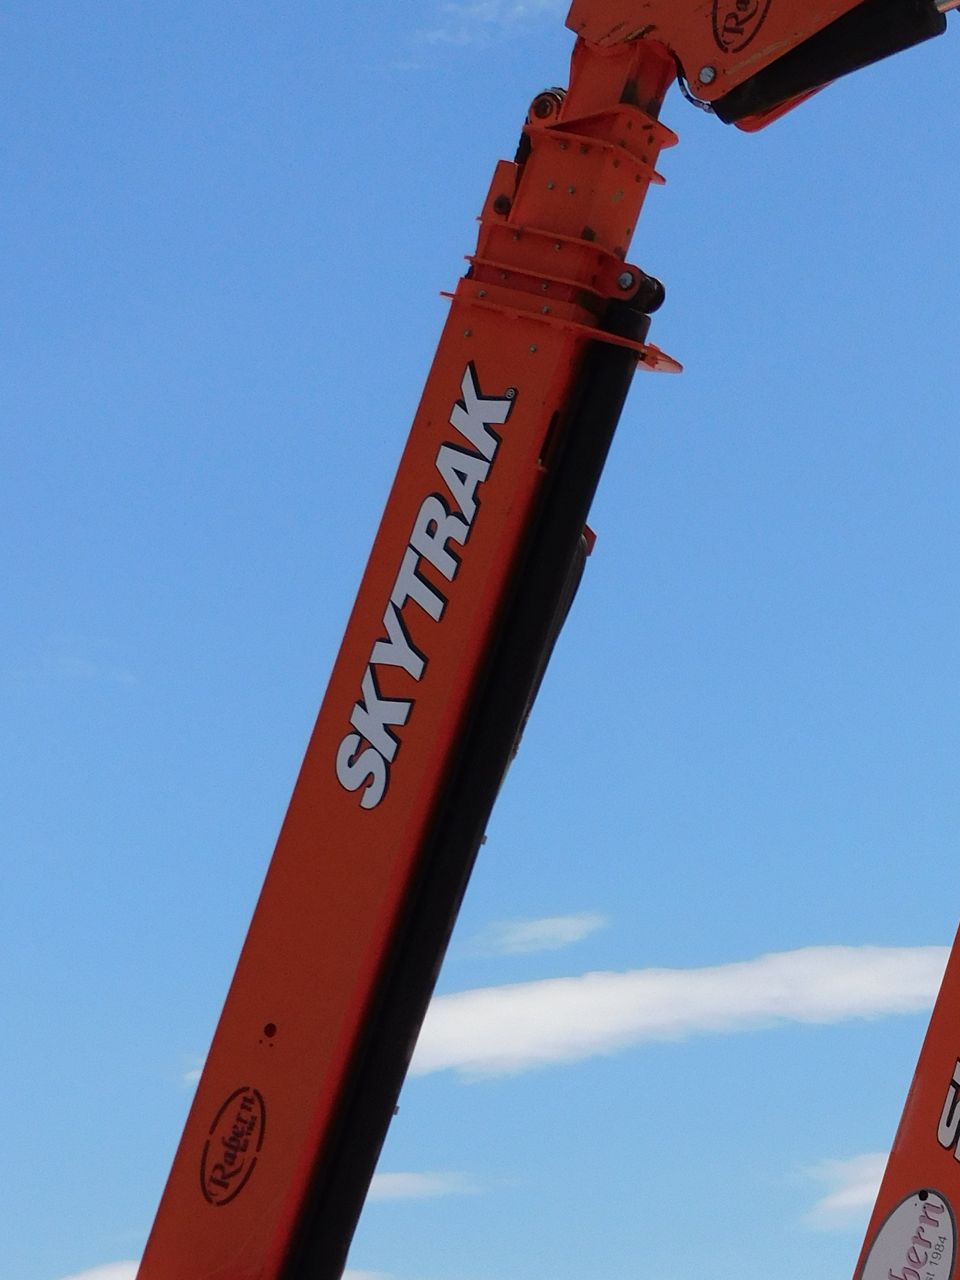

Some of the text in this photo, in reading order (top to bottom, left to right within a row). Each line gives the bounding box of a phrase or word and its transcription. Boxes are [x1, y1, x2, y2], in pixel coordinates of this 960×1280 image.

[335, 360, 517, 810] SKYTRAK
[208, 1095, 255, 1197] Rabern
[930, 1235, 947, 1266] 1984
